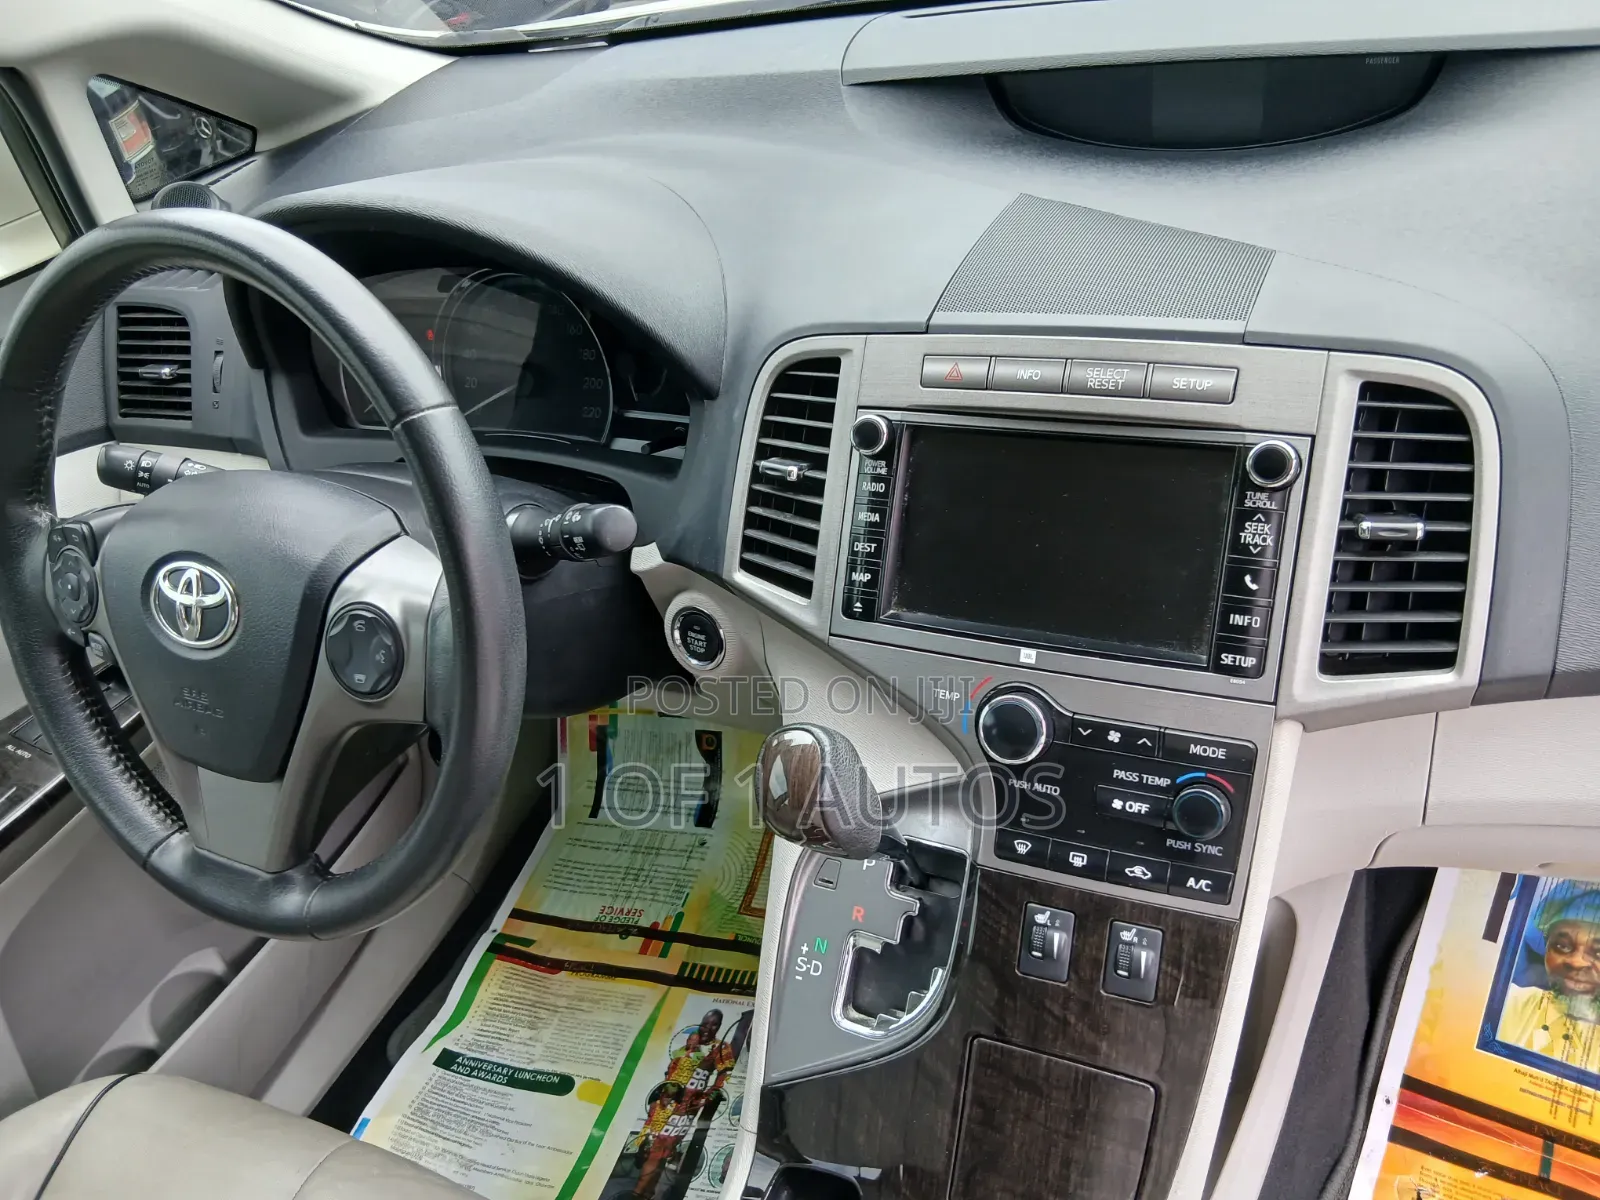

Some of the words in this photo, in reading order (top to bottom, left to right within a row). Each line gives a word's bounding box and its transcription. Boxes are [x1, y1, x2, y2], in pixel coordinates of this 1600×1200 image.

[1365, 56, 1400, 65] PASSENGER
[1016, 369, 1041, 381] INFO
[1086, 367, 1130, 380] SELECT
[1087, 378, 1125, 391] RESET
[1172, 377, 1213, 391] SETUP
[864, 459, 887, 468] POWER
[864, 466, 888, 475] VOLUME
[862, 481, 886, 493] RADIO
[1245, 491, 1269, 500] TUNE
[1244, 499, 1278, 510] SCROLL
[858, 511, 880, 523] MEDIA
[1244, 521, 1271, 535] SEEK
[1239, 532, 1274, 547] TRACK
[853, 541, 877, 553] DEST
[851, 571, 872, 583] MAP
[1229, 613, 1261, 628] INFO
[686, 637, 708, 648] START
[689, 644, 706, 653] STOP
[1220, 653, 1257, 668] SETUP
[933, 688, 961, 702] TEMP
[1189, 743, 1227, 760] MODE
[1112, 769, 1140, 783] PASS
[1141, 774, 1171, 788] TEMP
[1008, 778, 1032, 790] PUSH
[1032, 782, 1061, 796] AUTO
[1125, 801, 1151, 815] OFF
[1166, 838, 1192, 851] PUSH
[1194, 843, 1224, 857] SYNC
[863, 859, 876, 870] P
[1186, 876, 1213, 892] A/C
[594, 914, 607, 922] OF
[598, 905, 645, 918] SERVICE
[852, 905, 865, 922] R
[608, 915, 640, 925] PLEDGE
[736, 934, 762, 945] OUNCIL
[814, 937, 829, 954] N
[450, 1063, 471, 1075] AND
[471, 1069, 508, 1084] AWARDS
[455, 1056, 514, 1076] ANNIVERSARY
[514, 1069, 560, 1084] LUNCHEON
